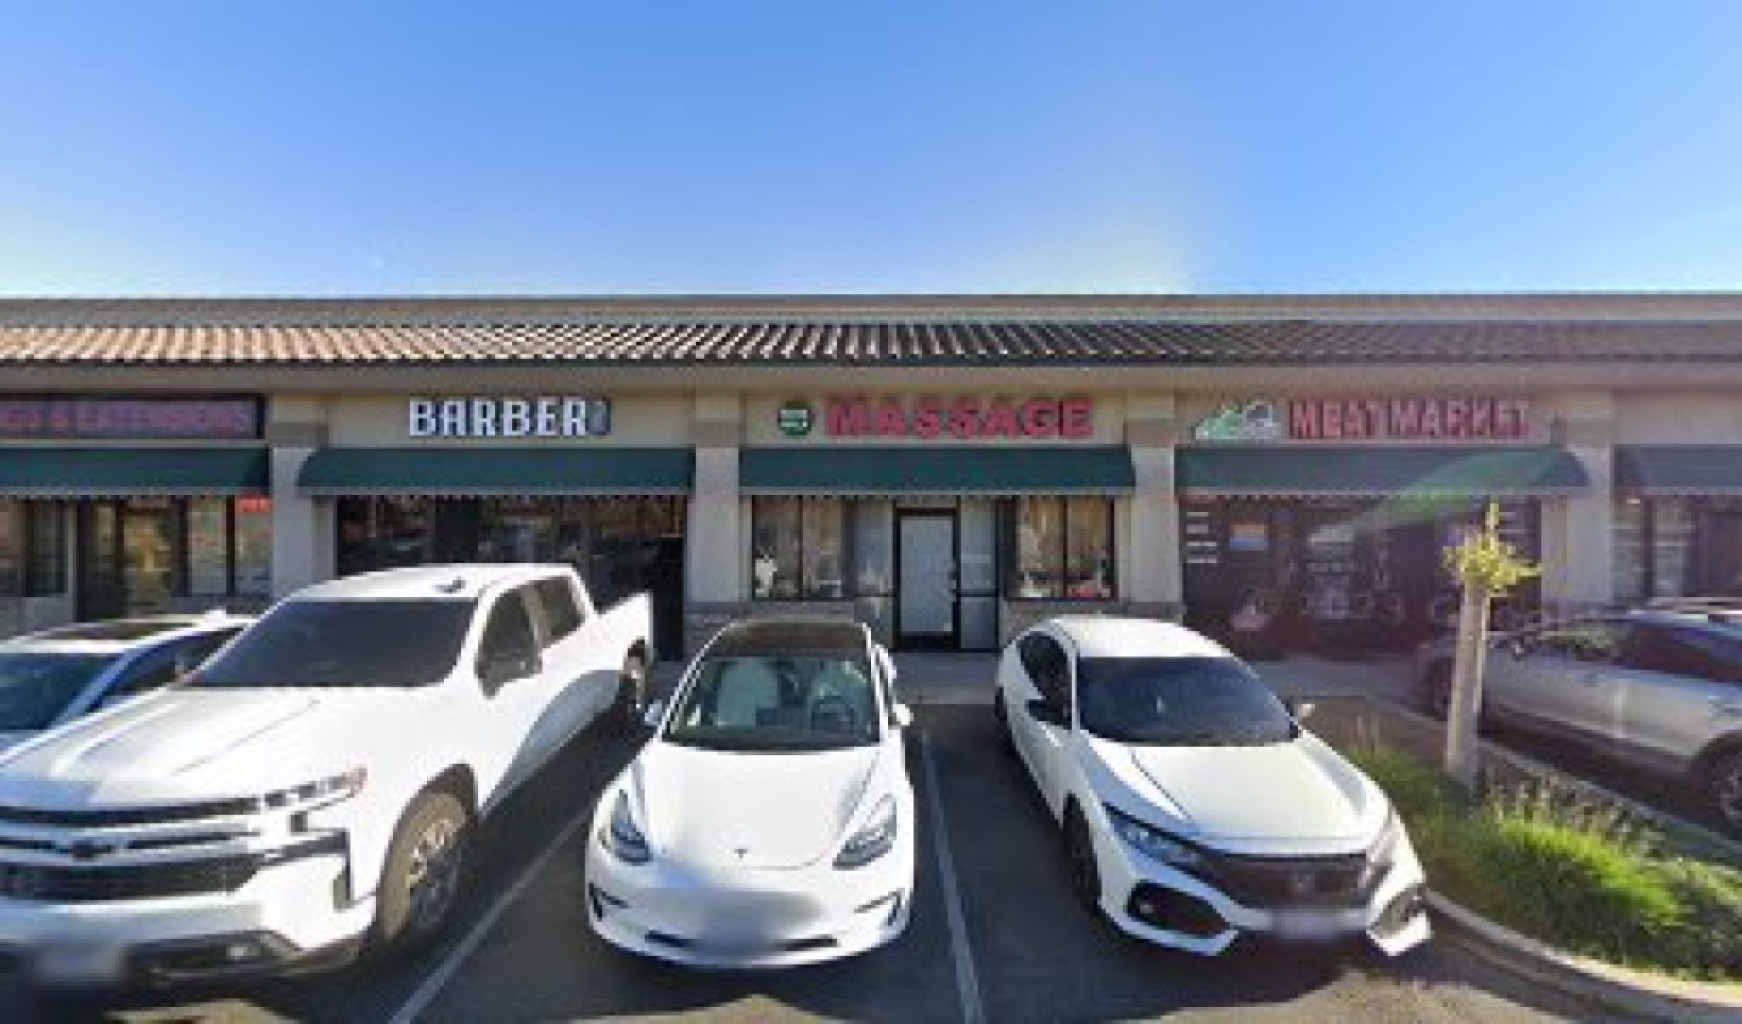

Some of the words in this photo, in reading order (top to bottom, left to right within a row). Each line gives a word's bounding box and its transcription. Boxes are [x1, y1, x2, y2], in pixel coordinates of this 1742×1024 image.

[409, 397, 588, 437] BARBER
[825, 398, 1094, 437] MASSAGE
[1288, 399, 1385, 439] MEAT
[1388, 399, 1530, 439] MARKET
